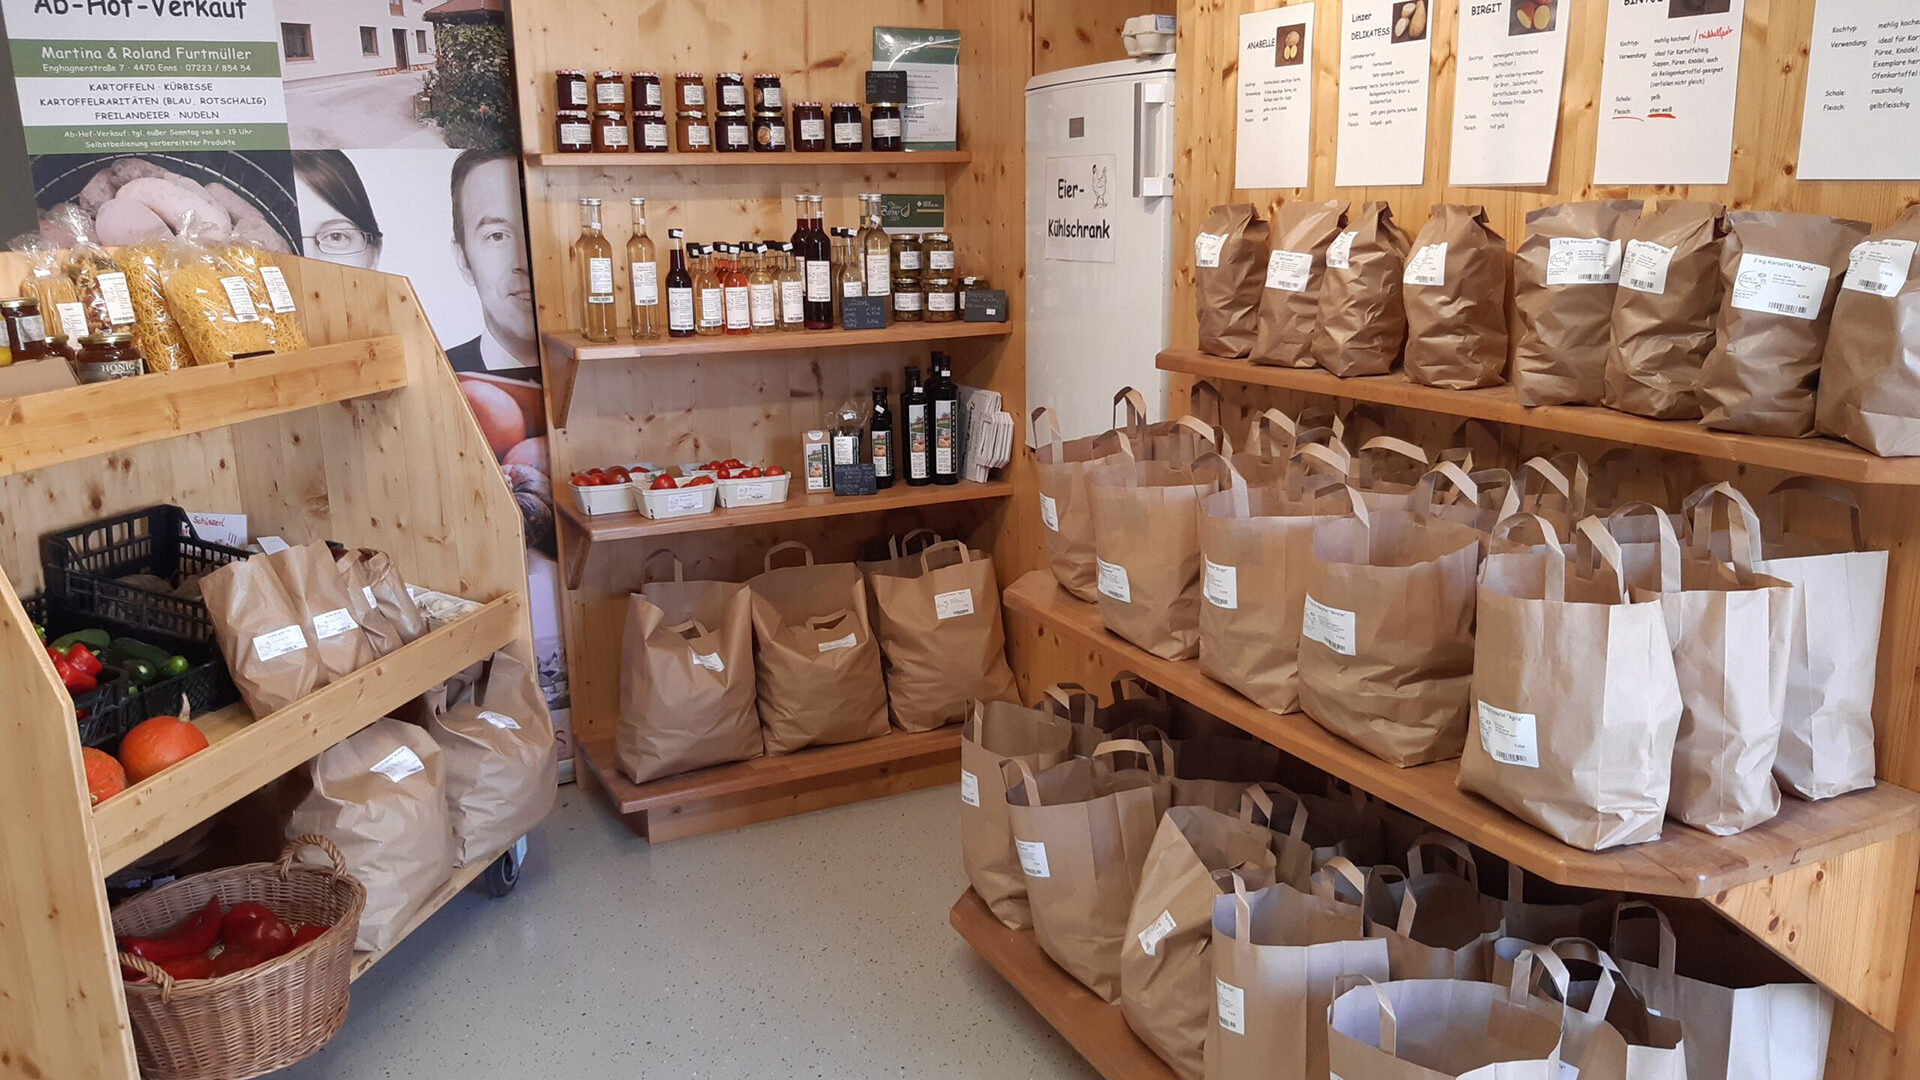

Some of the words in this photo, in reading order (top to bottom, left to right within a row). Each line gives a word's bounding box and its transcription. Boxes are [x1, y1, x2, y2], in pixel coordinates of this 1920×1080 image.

[1471, 3, 1503, 17] BIRGIT
[1351, 12, 1373, 24] Linzer
[1878, 21, 1899, 30] mehlig
[1350, 26, 1391, 41] DELIKATESS
[1878, 36, 1894, 44] ideal
[1895, 35, 1907, 43] für
[1246, 38, 1275, 50] ANABELLE
[41, 46, 102, 60] Martina
[107, 47, 117, 60] &
[122, 47, 171, 60] Roland
[176, 47, 252, 61] Furtmüller
[43, 63, 117, 74] Enghagnerstraße
[119, 64, 125, 72] 7
[133, 63, 155, 73] 4470
[157, 64, 179, 73] Enns
[185, 64, 212, 73] 07223
[222, 64, 238, 73] 854
[240, 64, 251, 73] 54
[1873, 60, 1907, 69] Exemplare
[1871, 70, 1918, 80] Ofenkartoffel
[89, 82, 155, 91] KARTOFFELN
[164, 81, 213, 92] KÜRBISSE
[1871, 86, 1904, 95] rauschalig
[39, 95, 159, 107] KARTOFFELRARITÄTEN
[200, 96, 267, 107] ROTSCHALIG)
[1869, 101, 1910, 111] gelbfleischig
[95, 111, 170, 121] FREILANDEIER
[179, 110, 219, 120] NUDELN
[169, 128, 201, 139] Sonntag
[239, 127, 254, 136] Uhr
[85, 140, 148, 150] Selbstbedienung
[150, 138, 202, 149] vorbereiteter
[203, 138, 237, 148] Produkte
[1057, 178, 1085, 199] Eier-
[1048, 218, 1110, 239] Kühlschrank
[1768, 259, 1794, 268] Kartoffel
[1795, 263, 1817, 271] "Agria"
[101, 363, 135, 372] HONIG
